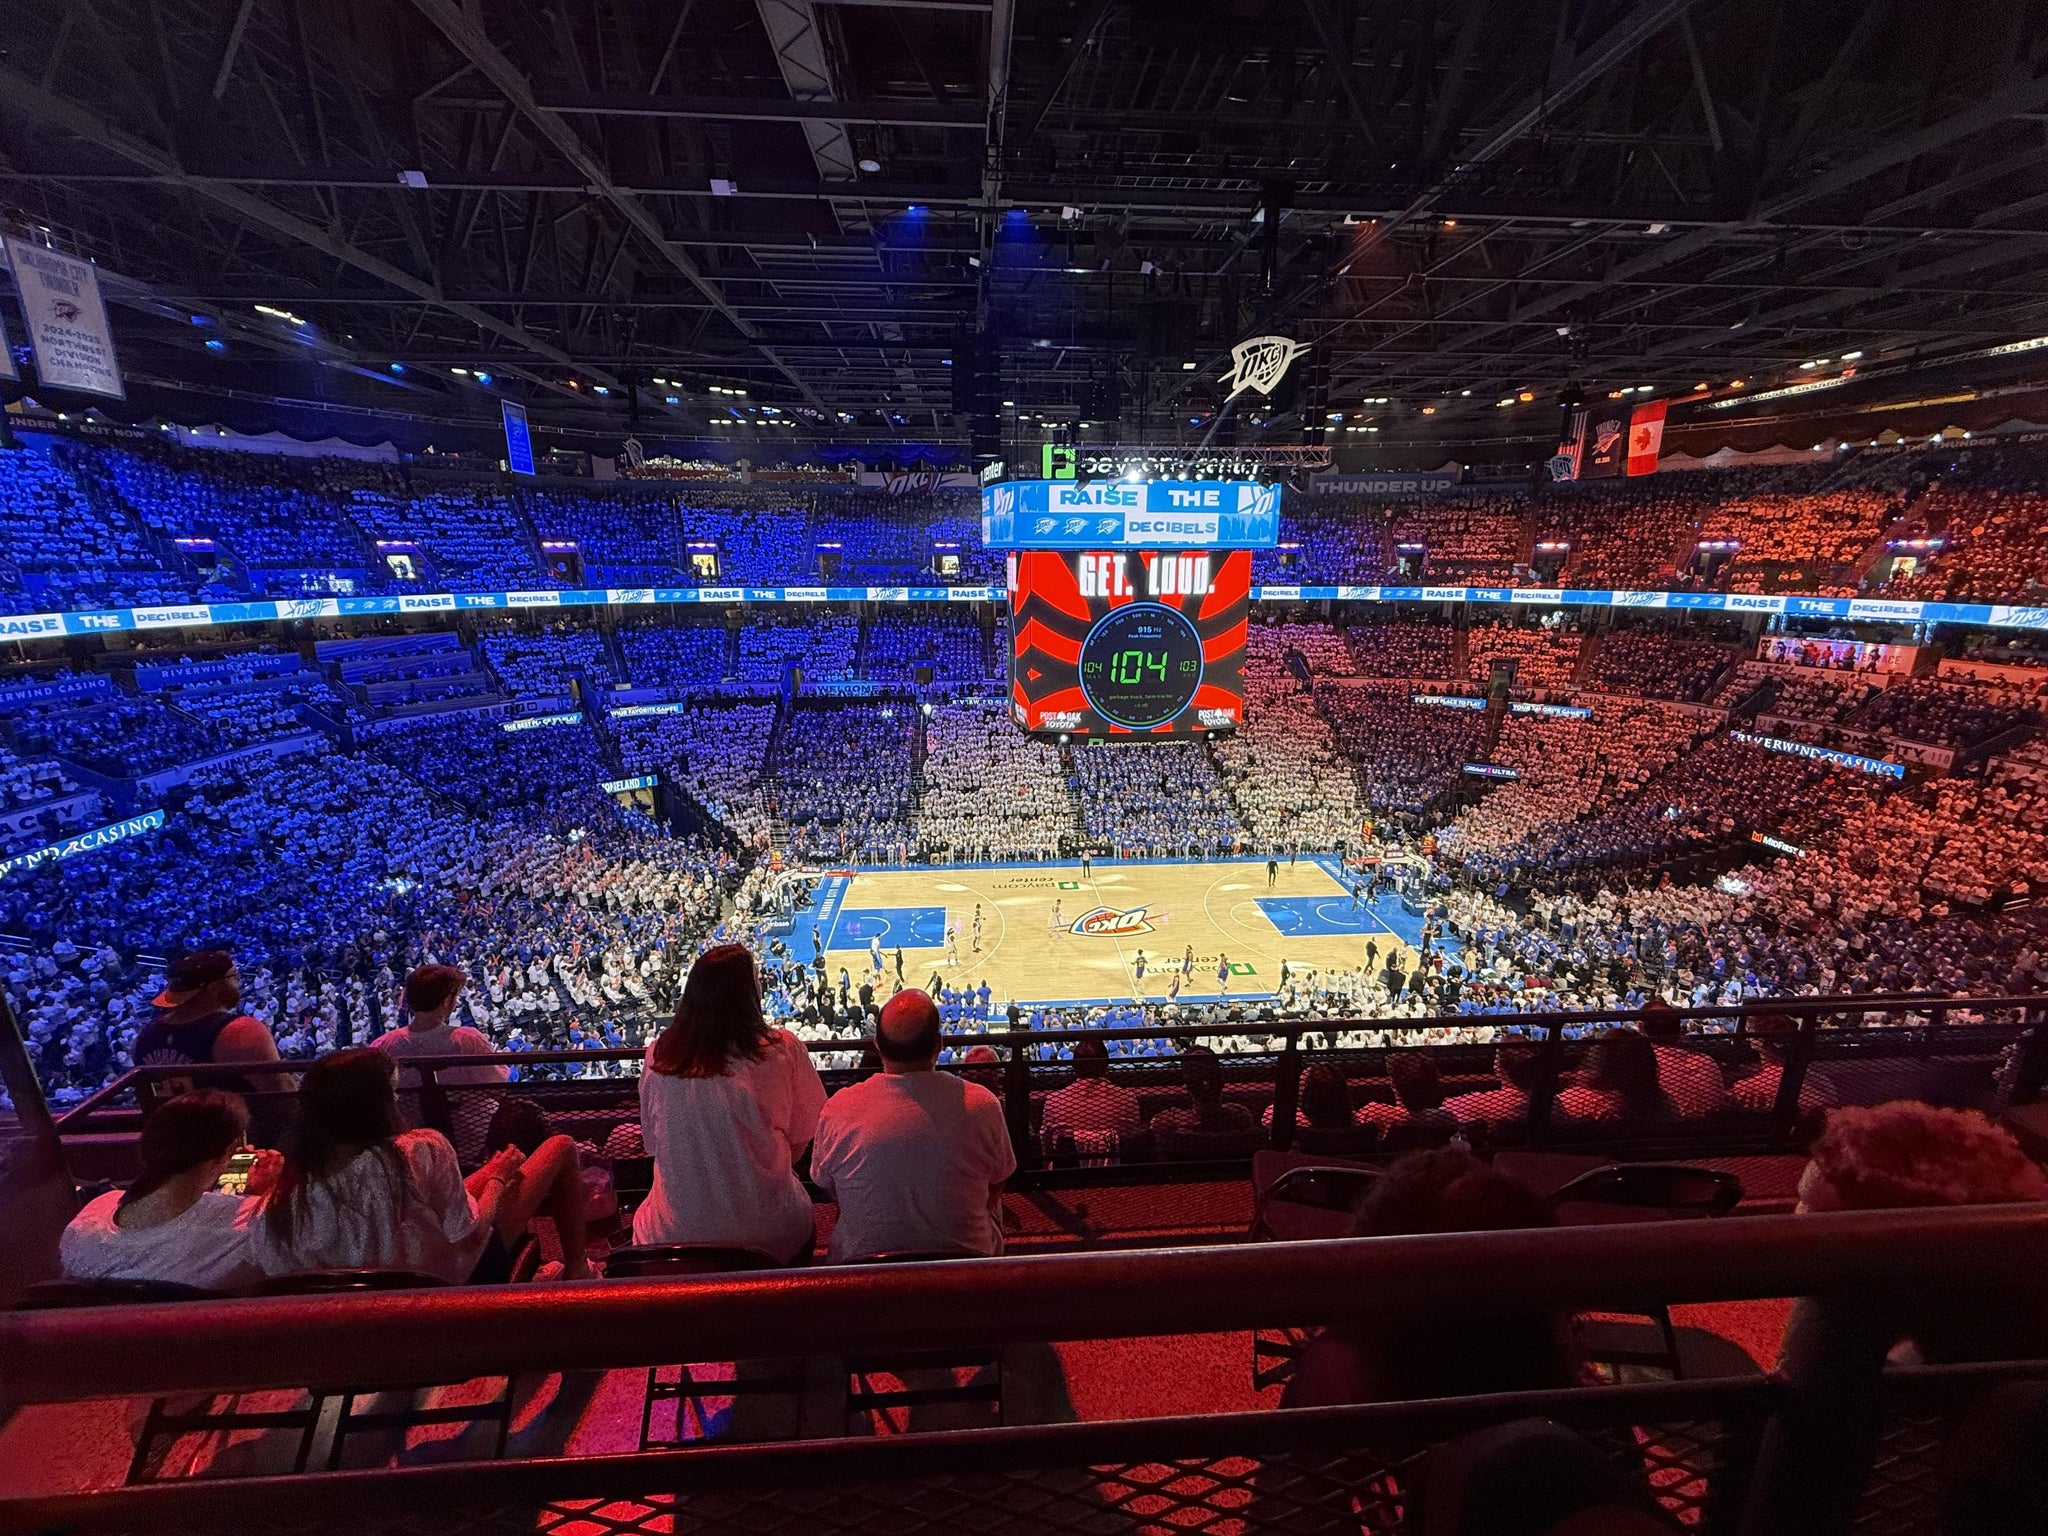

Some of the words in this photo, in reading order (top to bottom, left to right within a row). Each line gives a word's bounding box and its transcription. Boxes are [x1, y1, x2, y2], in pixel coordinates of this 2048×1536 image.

[55, 348, 101, 365] DIVISION
[1317, 481, 1417, 494] THUNDER
[1421, 480, 1451, 491] UP
[1060, 490, 1138, 506] RAISE
[1168, 490, 1220, 507] THE
[1129, 521, 1216, 534] DECIBELS
[1080, 556, 1134, 596] GET.
[1148, 557, 1215, 596] LOUD.
[703, 590, 740, 599] RAISE
[752, 590, 776, 599] THE
[952, 590, 985, 598] RAISE
[1262, 589, 1299, 597] DECIBELS
[1426, 590, 1463, 598] RAISE
[1474, 591, 1501, 599] THE
[1513, 592, 1560, 600] DECIBELS
[405, 597, 452, 608] RAISE
[465, 595, 495, 605] THE
[509, 594, 558, 603] DECIBELS
[1732, 598, 1779, 608] RAISE
[1798, 600, 1833, 612] THE
[1852, 603, 1919, 615] DECIBELS
[79, 614, 121, 628] THE
[136, 611, 209, 622] DECIBELS
[1857, 652, 1902, 665] TERACE
[161, 663, 232, 678] RIVERWIND
[1084, 661, 1102, 673] 104
[1110, 650, 1168, 684] 104
[1179, 660, 1197, 672] 103
[58, 679, 106, 693] CASINO
[817, 685, 878, 693] WELCOME
[1199, 710, 1215, 720] POST
[1223, 709, 1235, 719] OAK
[1513, 704, 1531, 712] YOUR
[1040, 711, 1056, 721] POST
[1067, 712, 1082, 722] OAK
[1203, 718, 1230, 726] TOYOTA
[1045, 721, 1075, 729] TOYOTA
[1492, 769, 1516, 777] ULTRA
[80, 815, 158, 851] CASINO
[992, 882, 1056, 890] paycom
